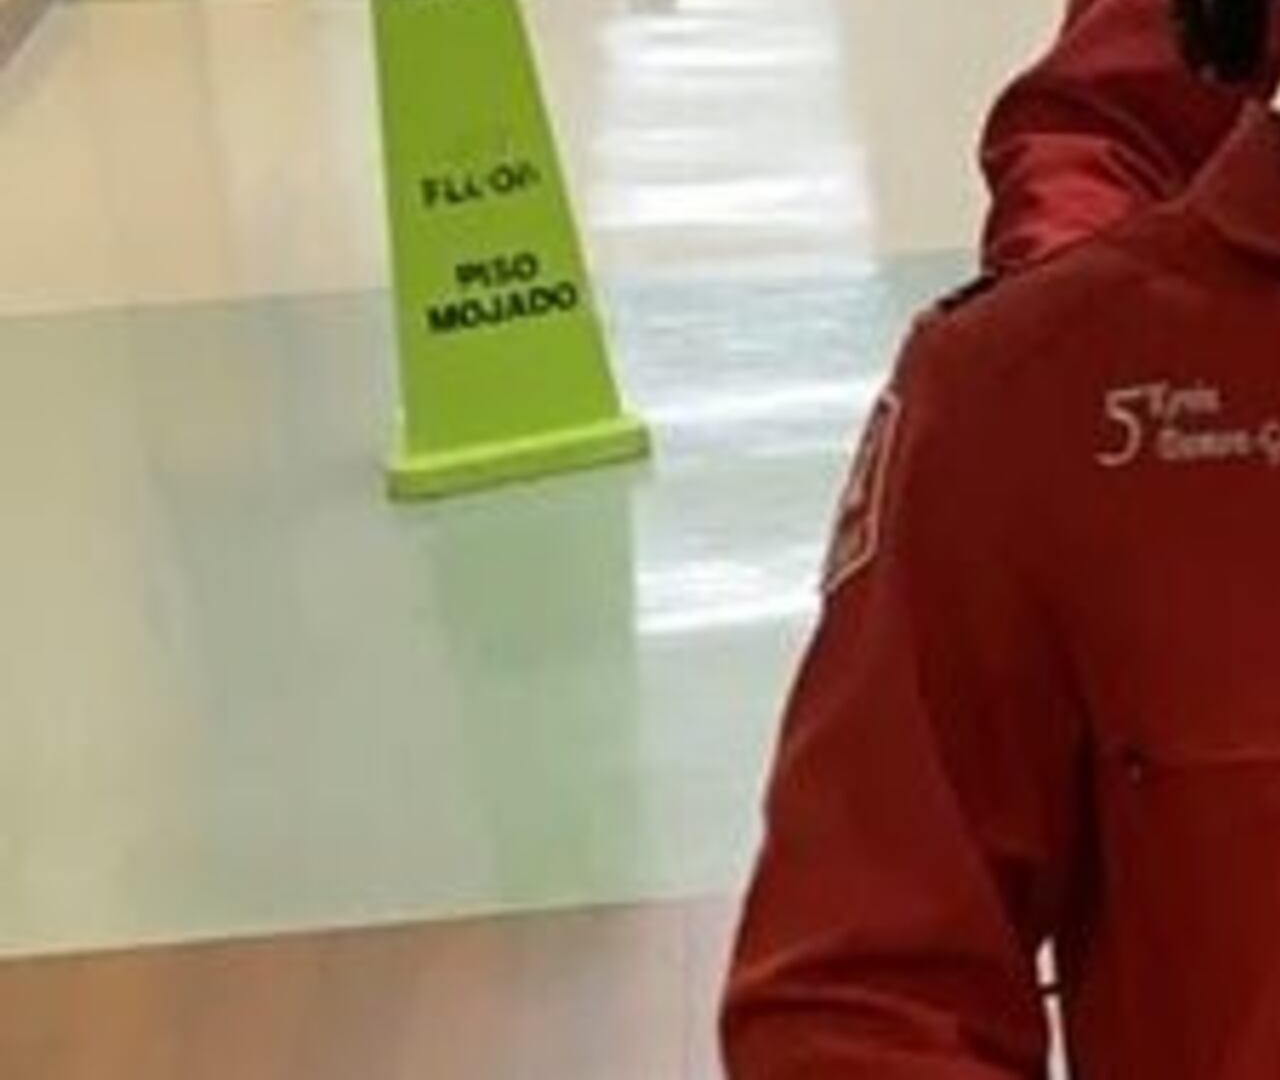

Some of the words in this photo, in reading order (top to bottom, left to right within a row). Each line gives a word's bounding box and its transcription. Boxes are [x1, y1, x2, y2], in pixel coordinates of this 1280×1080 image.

[455, 252, 539, 288] PISO
[428, 281, 577, 333] MOJADO
[1096, 386, 1143, 466] 5
